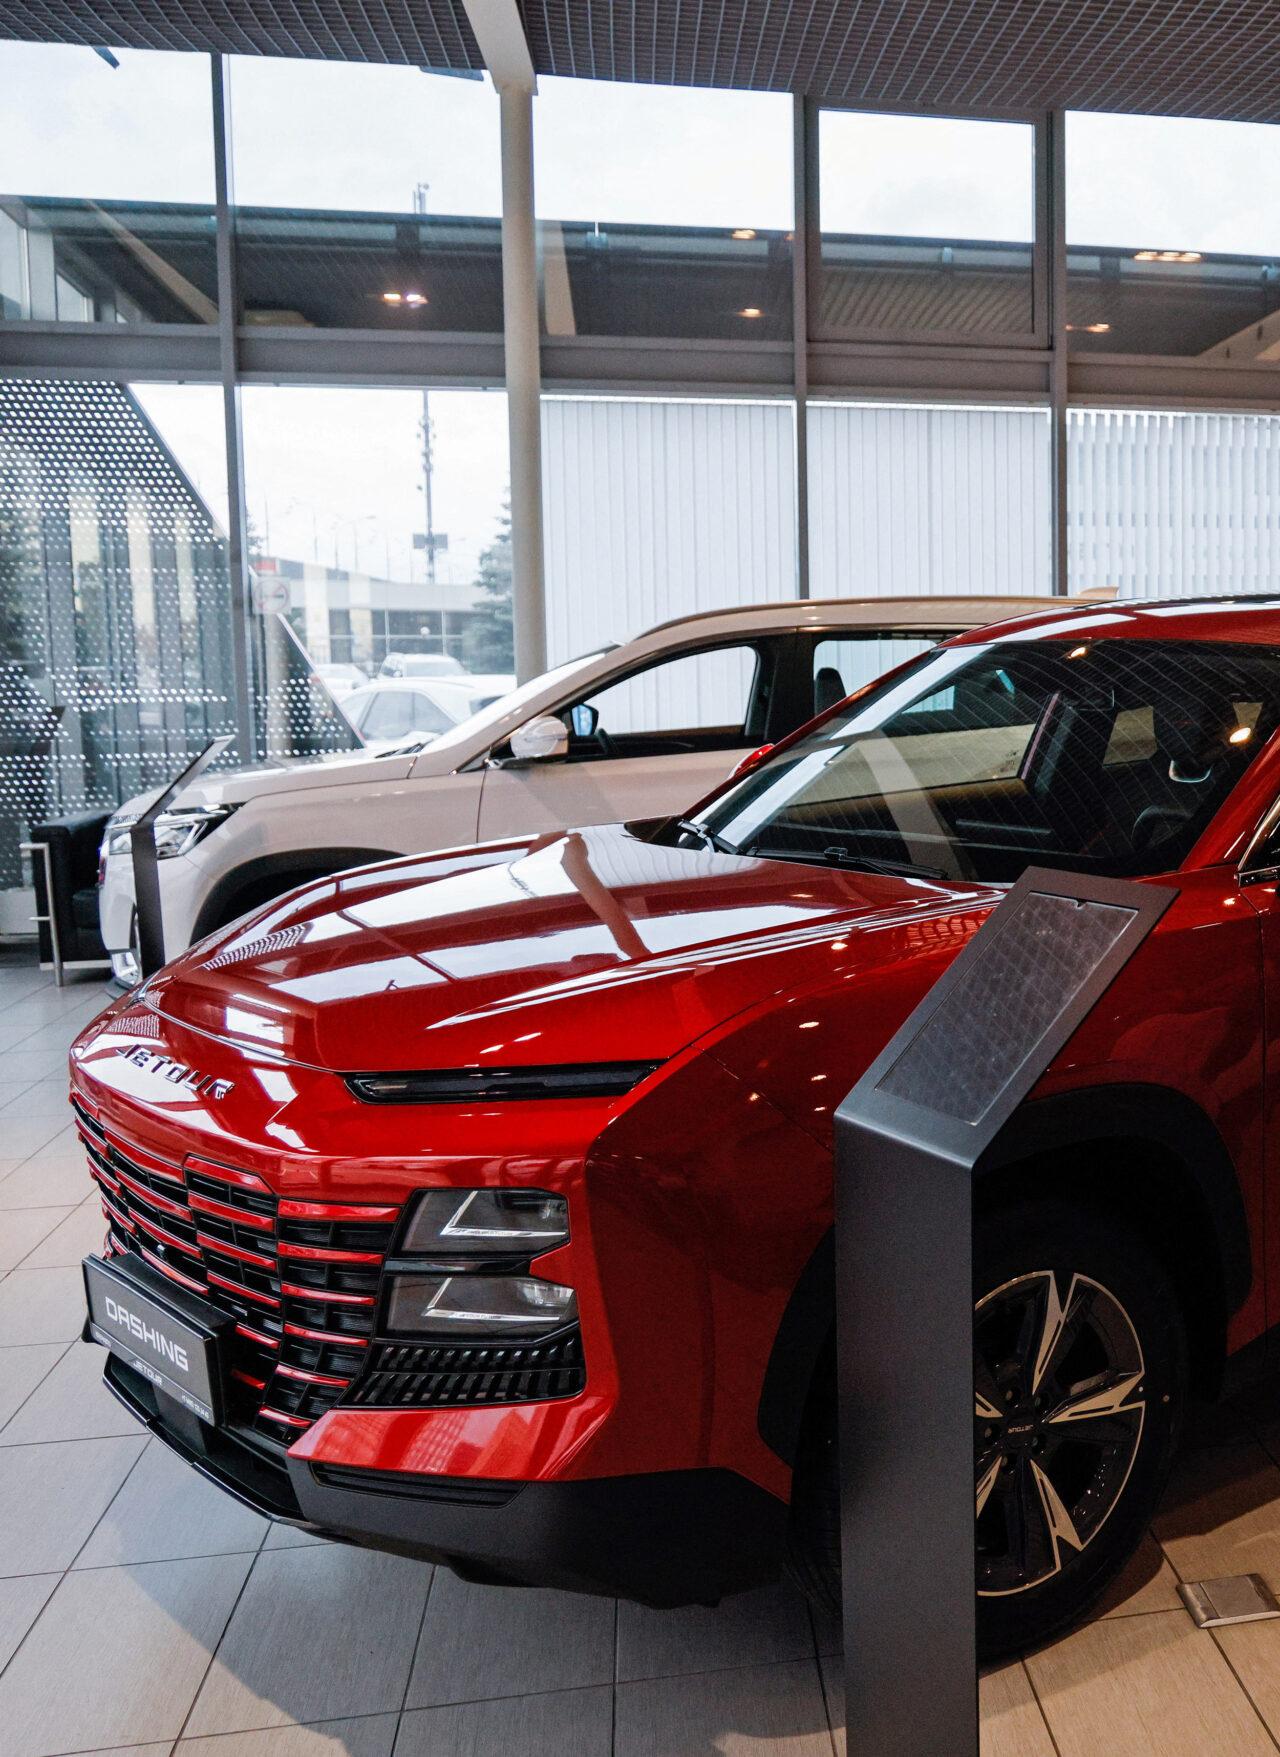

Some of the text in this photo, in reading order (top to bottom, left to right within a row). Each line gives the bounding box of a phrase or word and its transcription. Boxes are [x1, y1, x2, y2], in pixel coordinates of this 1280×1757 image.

[115, 1044, 235, 1100] JETOUR
[105, 1296, 189, 1372] DASHING
[133, 1360, 163, 1386] JETOUR
